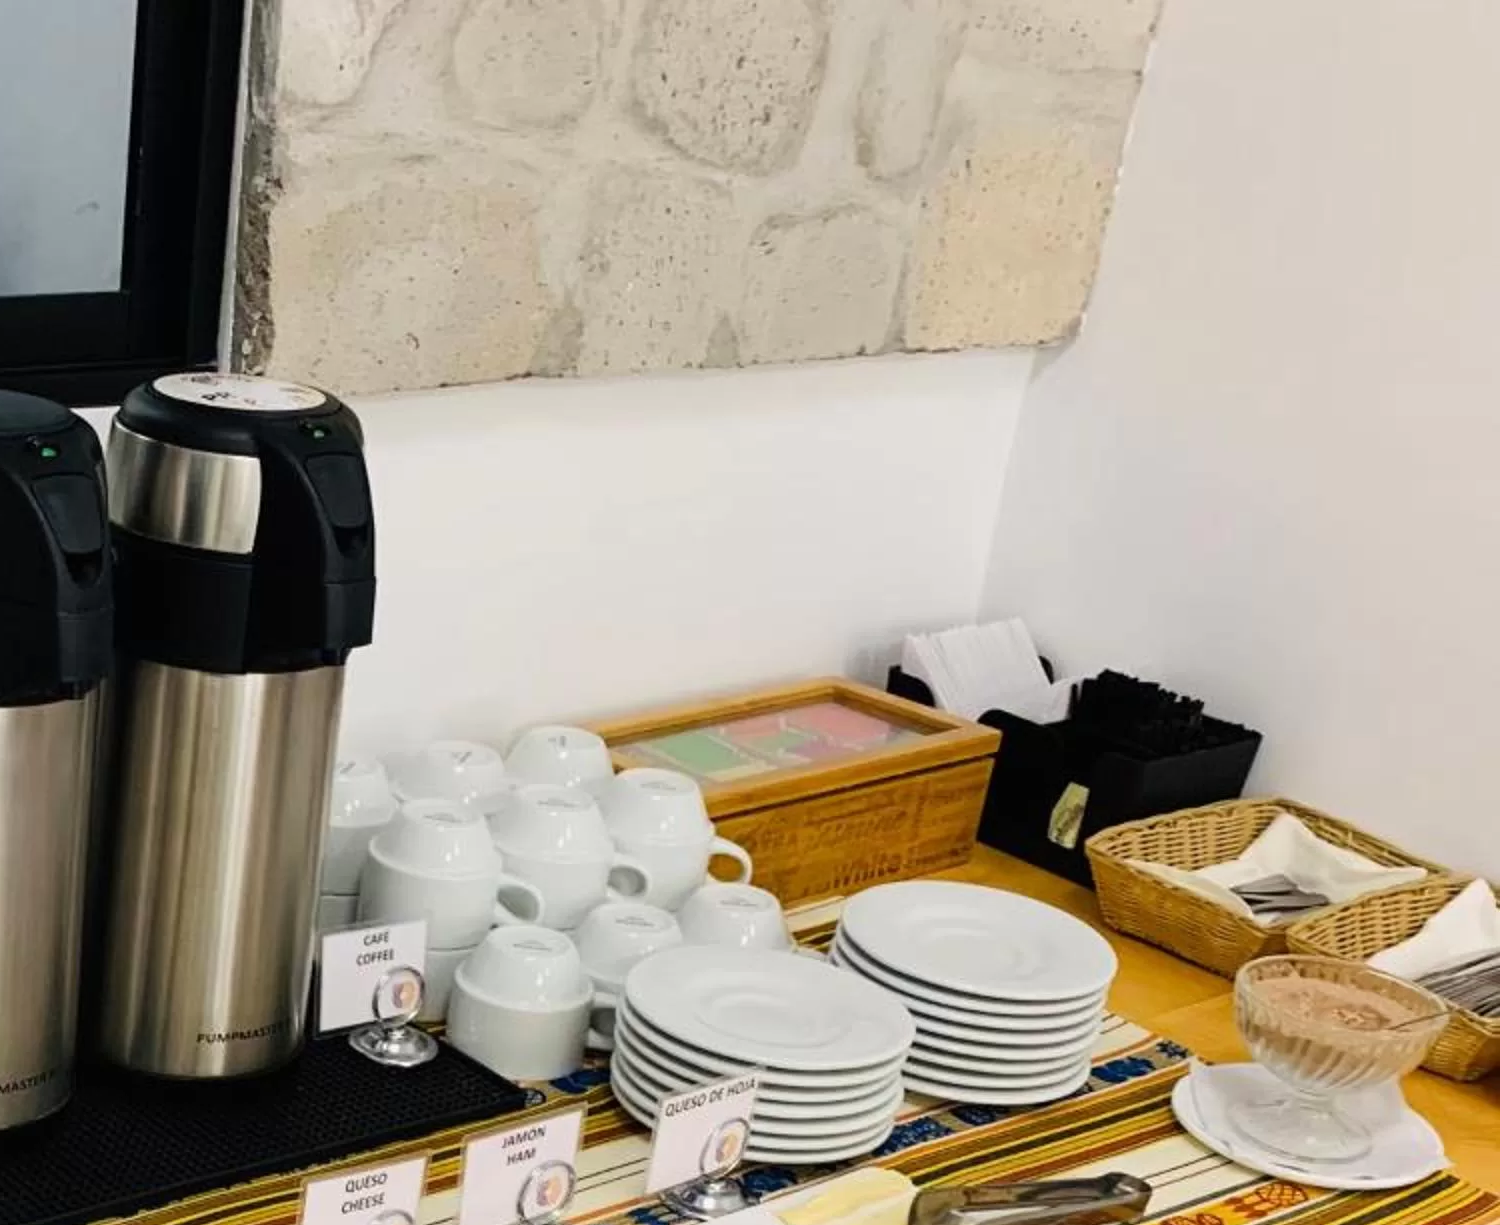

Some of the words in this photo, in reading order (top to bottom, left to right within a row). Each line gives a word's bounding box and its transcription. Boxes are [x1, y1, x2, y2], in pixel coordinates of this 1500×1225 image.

[355, 948, 395, 966] COFFEE
[665, 1092, 707, 1117] QUESO
[709, 1087, 725, 1104] DE
[501, 1125, 546, 1149] JAMON
[506, 1149, 537, 1166] HAM
[345, 1172, 388, 1193] QUESO
[341, 1192, 385, 1215] CHEESE
